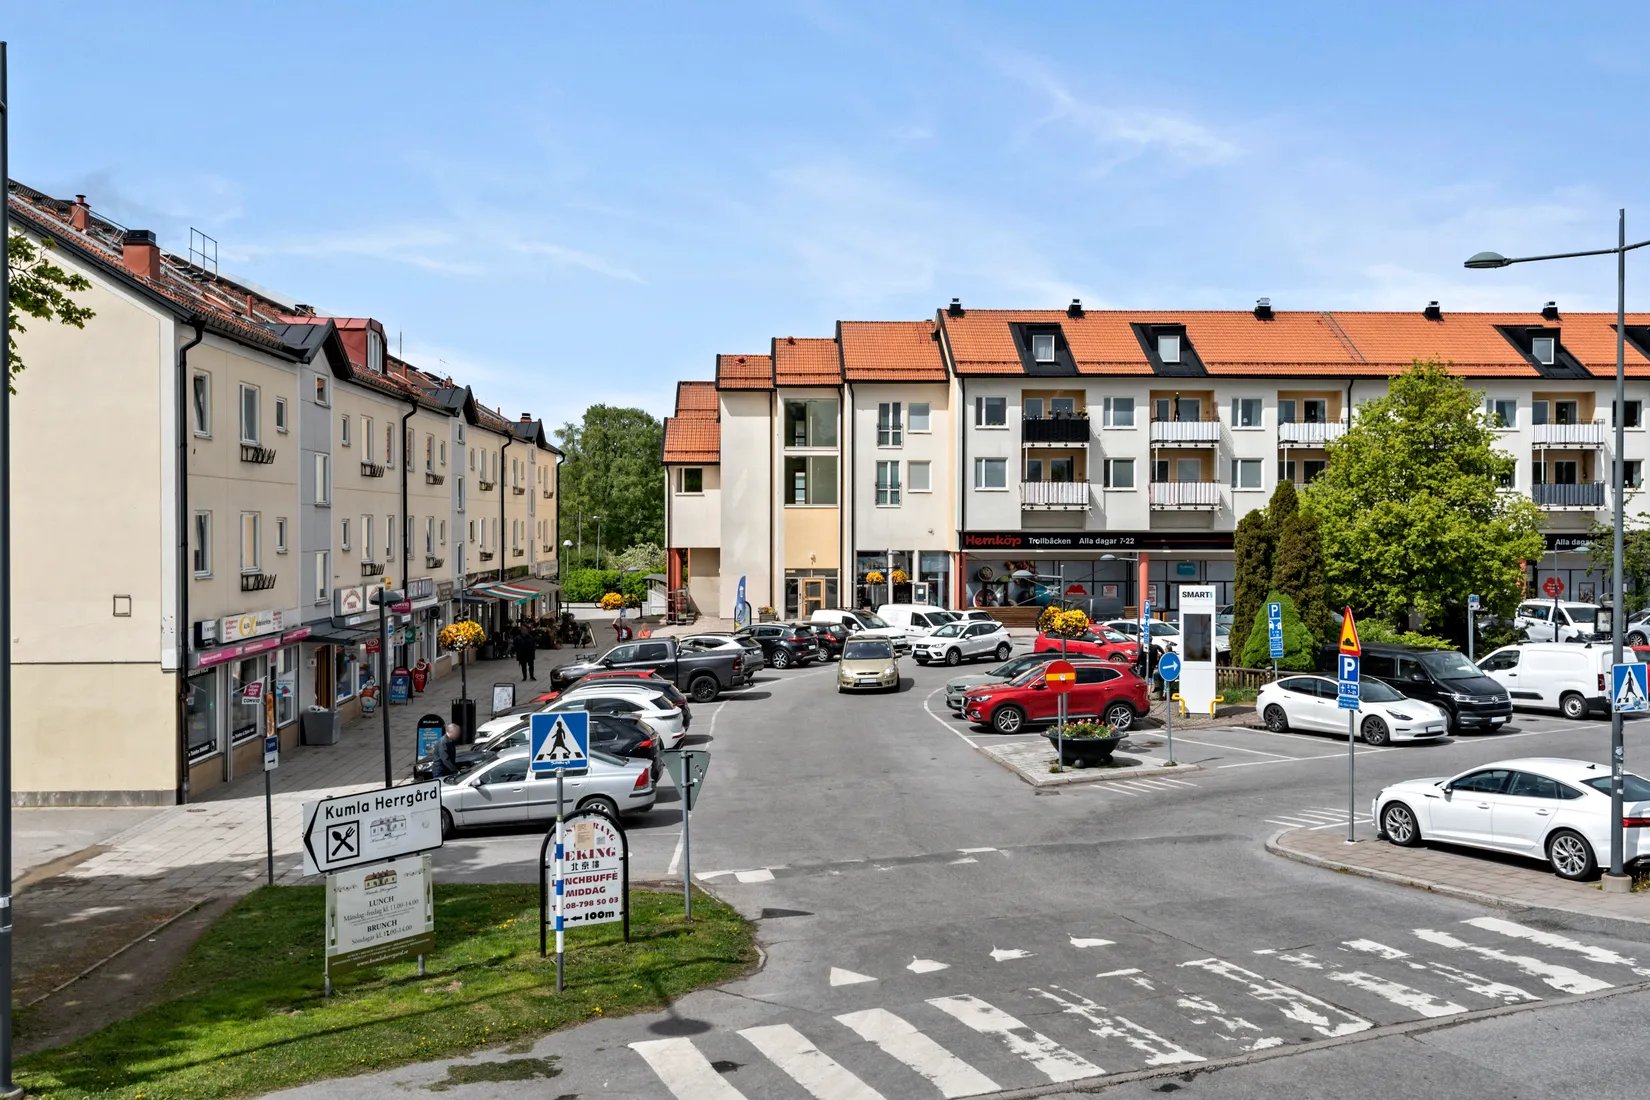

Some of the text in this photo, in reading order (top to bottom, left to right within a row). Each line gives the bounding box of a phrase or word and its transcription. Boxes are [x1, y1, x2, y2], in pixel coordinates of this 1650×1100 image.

[965, 535, 1021, 547] Hemköp
[1028, 537, 1135, 547] Trollbäcken Alla dagar 7-22
[1271, 604, 1279, 617] P
[1343, 657, 1356, 679] P
[325, 786, 438, 820] Kumla Herrgård
[554, 847, 616, 863] EKING
[565, 886, 606, 898] MIDDAG
[368, 896, 395, 908] LUNCH
[585, 911, 615, 921] 100m
[367, 919, 398, 933] BRUNCH
